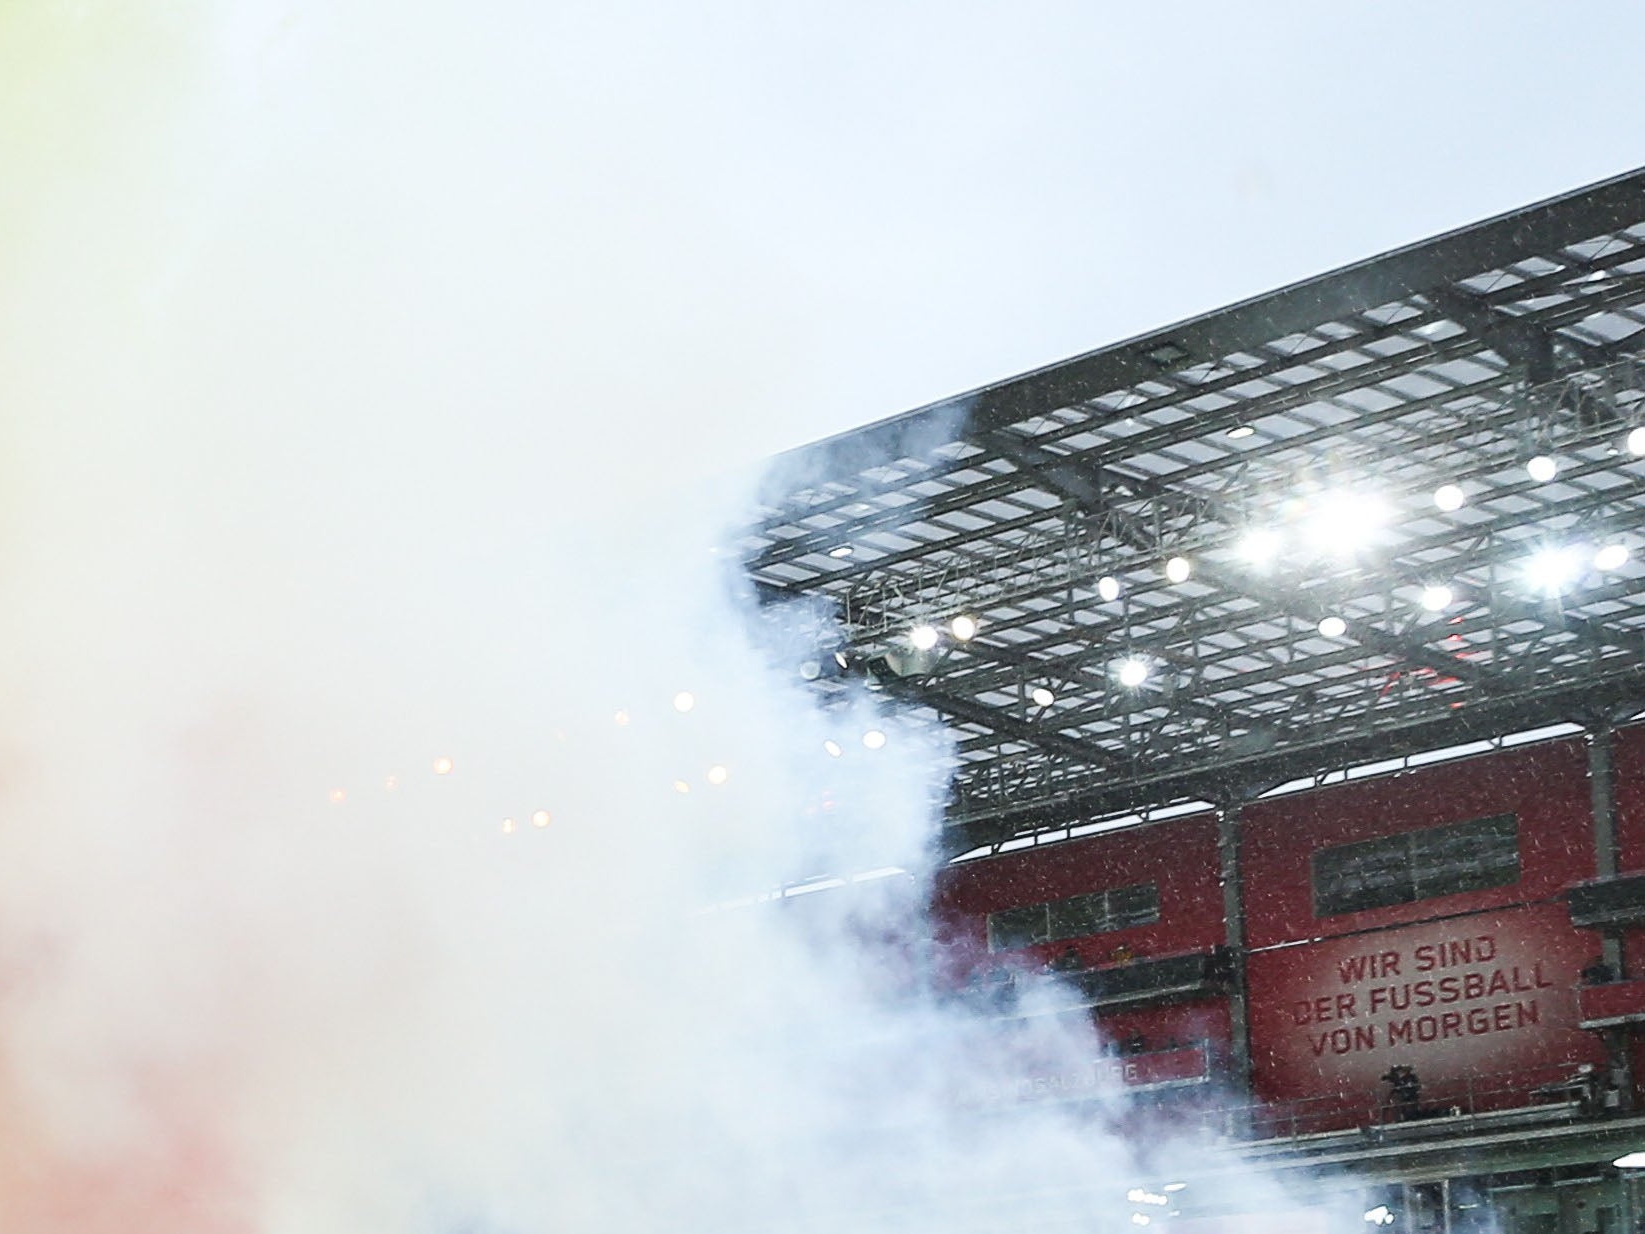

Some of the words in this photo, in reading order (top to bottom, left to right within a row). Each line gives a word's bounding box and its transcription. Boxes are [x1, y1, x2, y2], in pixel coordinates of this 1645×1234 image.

[1337, 952, 1401, 984] WIR
[1415, 936, 1496, 972] SIND
[1294, 993, 1356, 1026] DER
[1370, 963, 1554, 1014] FUSSBALL
[1310, 1024, 1375, 1057] VON
[1388, 1001, 1540, 1047] MORGEN
